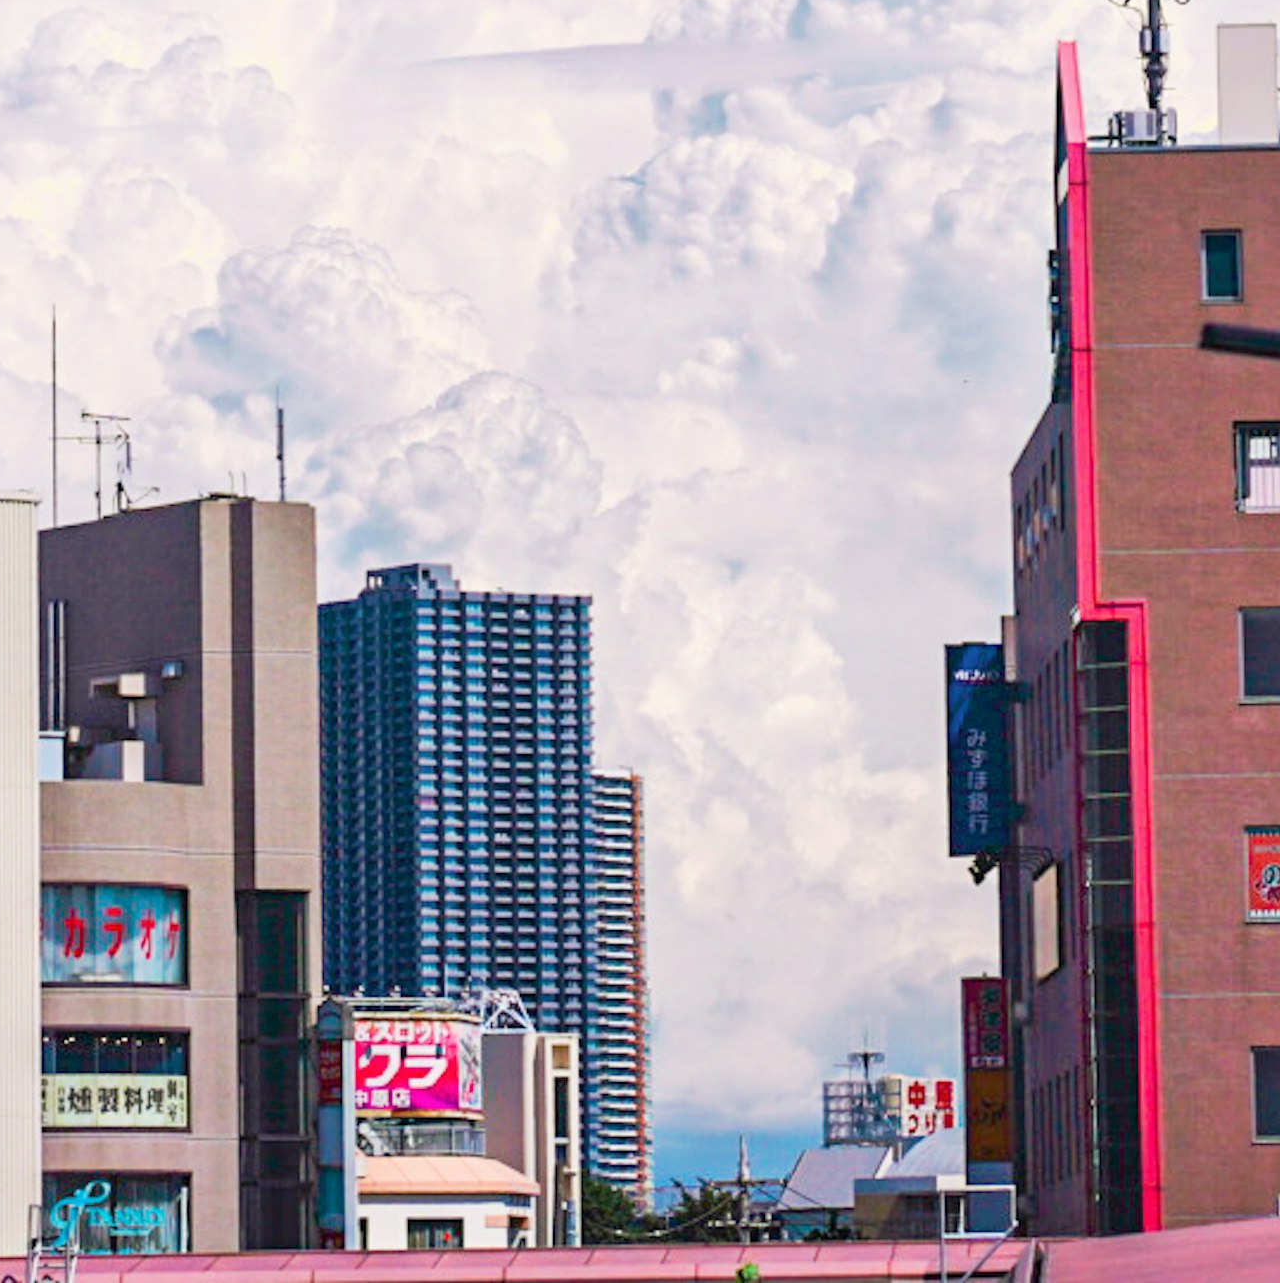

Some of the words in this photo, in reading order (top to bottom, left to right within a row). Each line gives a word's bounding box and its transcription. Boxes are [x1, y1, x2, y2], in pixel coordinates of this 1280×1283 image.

[64, 907, 181, 960] カラオケ
[355, 1021, 449, 1044] &スロット
[355, 1089, 412, 1109] 中原店
